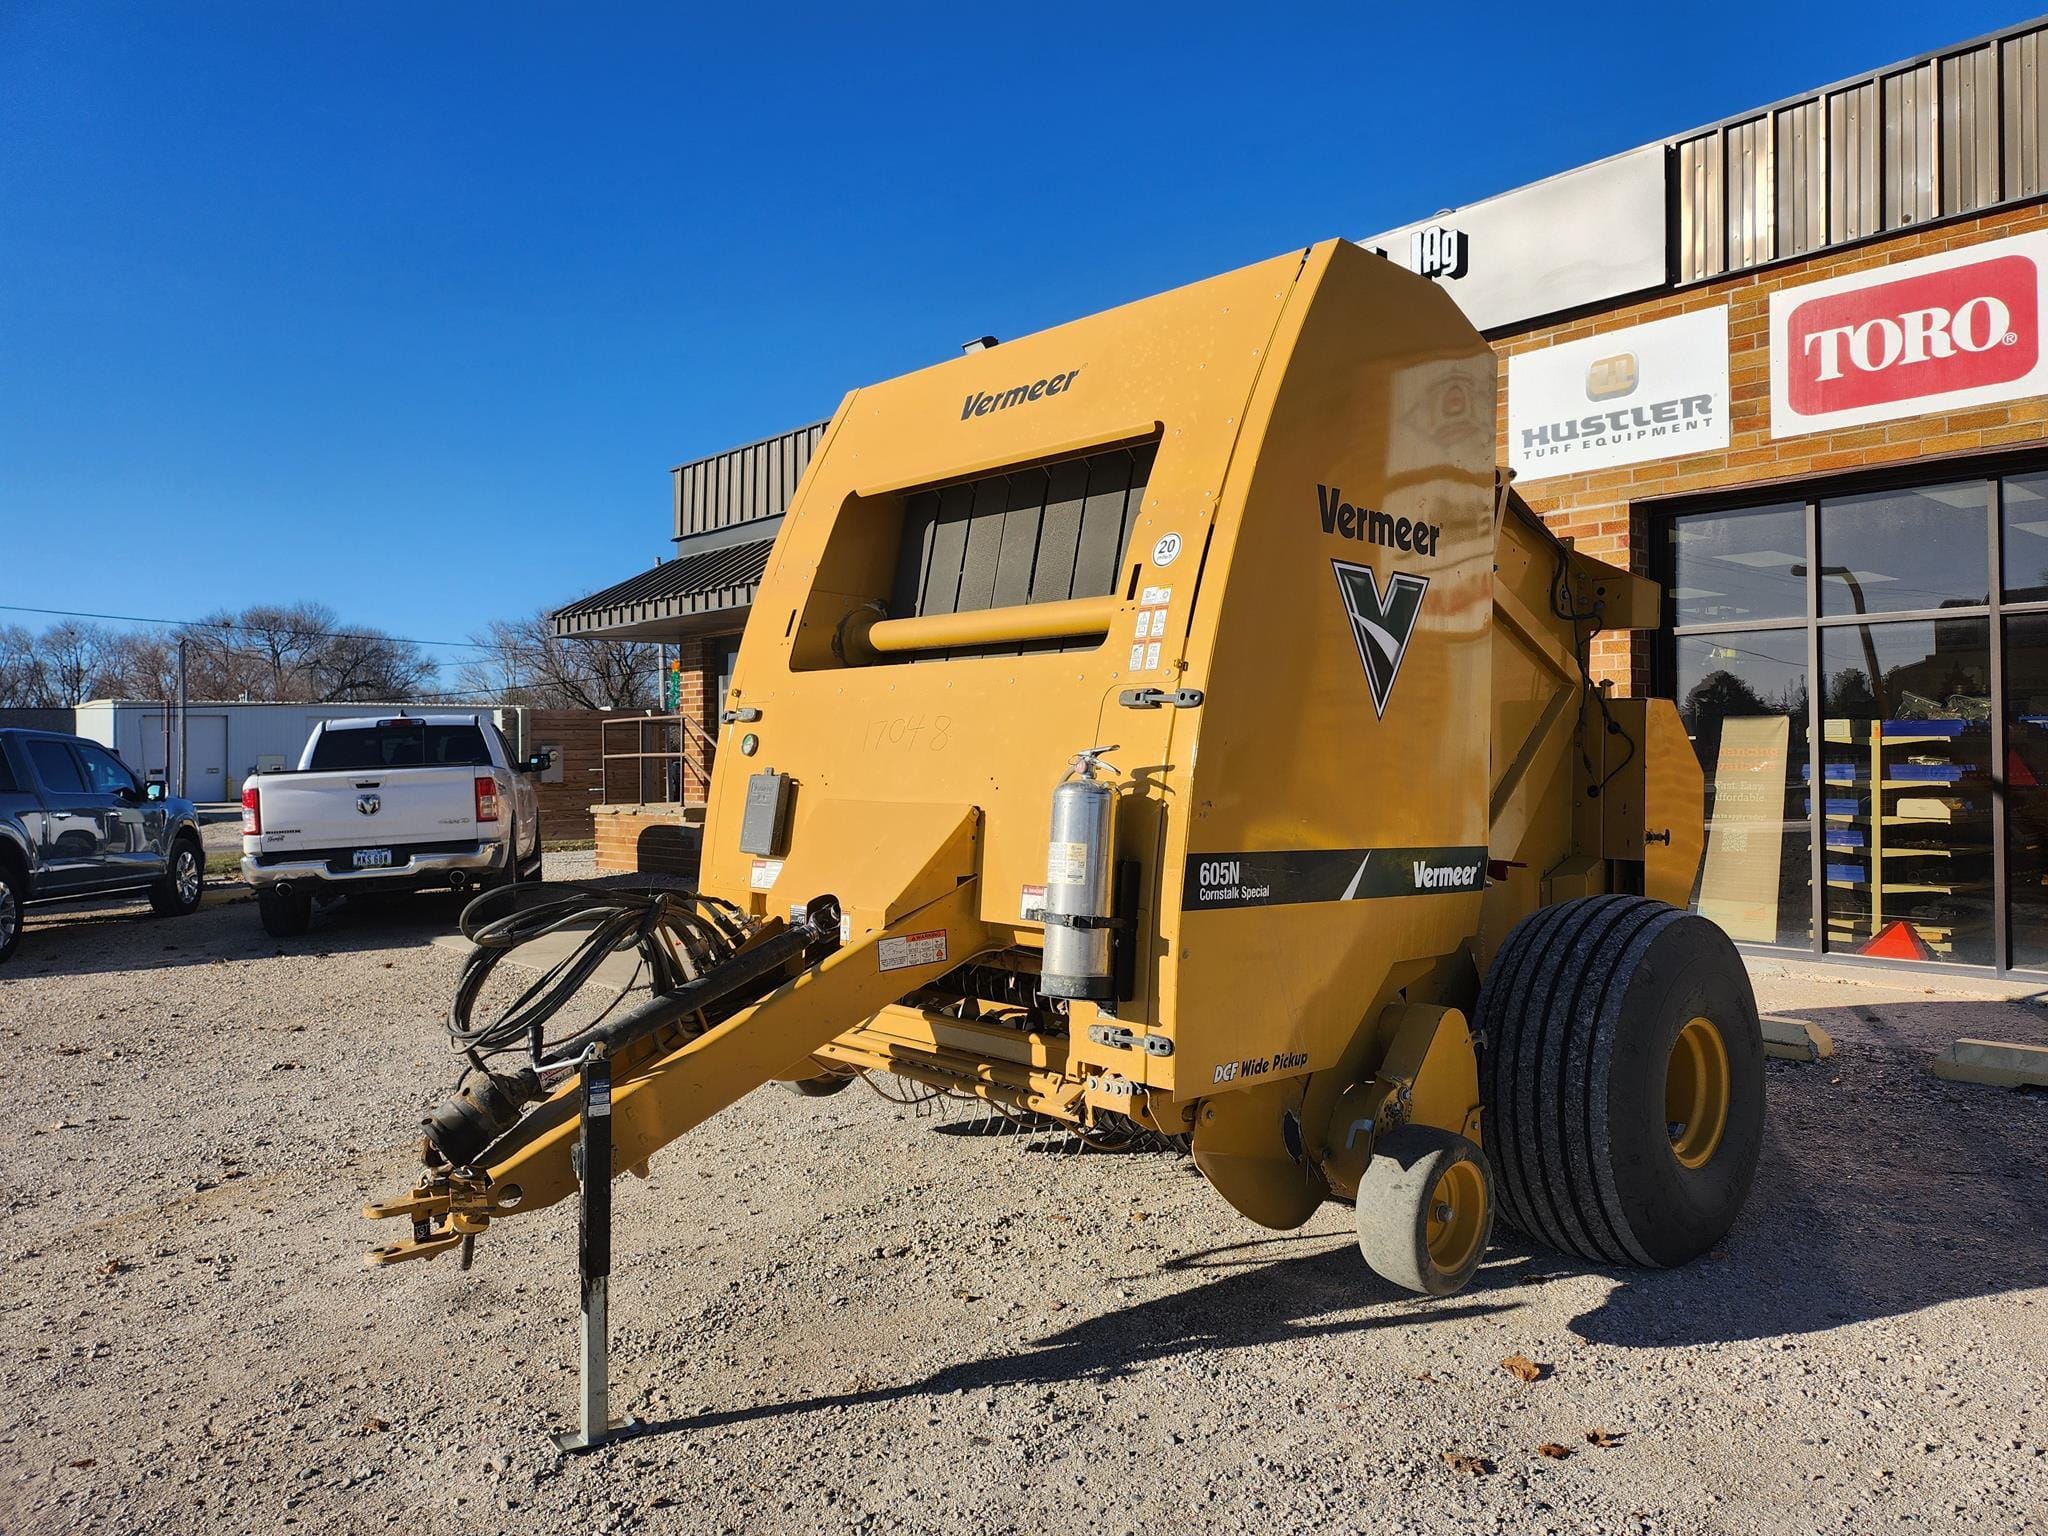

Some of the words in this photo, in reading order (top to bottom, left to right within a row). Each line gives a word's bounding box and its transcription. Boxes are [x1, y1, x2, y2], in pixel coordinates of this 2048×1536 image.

[1804, 296, 2011, 382] TORO
[960, 369, 1080, 421] Vermeer
[1521, 393, 1713, 449] HUSTLER
[1524, 444, 1573, 460] TURF
[1582, 417, 1713, 450] EQUIPMENT
[1316, 483, 1440, 557] Vermeer
[1158, 539, 1176, 554] 20
[1199, 861, 1240, 886] 605N
[1199, 886, 1240, 901] Cornstalk
[1241, 884, 1270, 900] Special
[1413, 860, 1478, 888] Vermeer
[1213, 1061, 1239, 1084] DCF
[1240, 1058, 1270, 1078] Wide
[1272, 1051, 1308, 1071] Pickup
